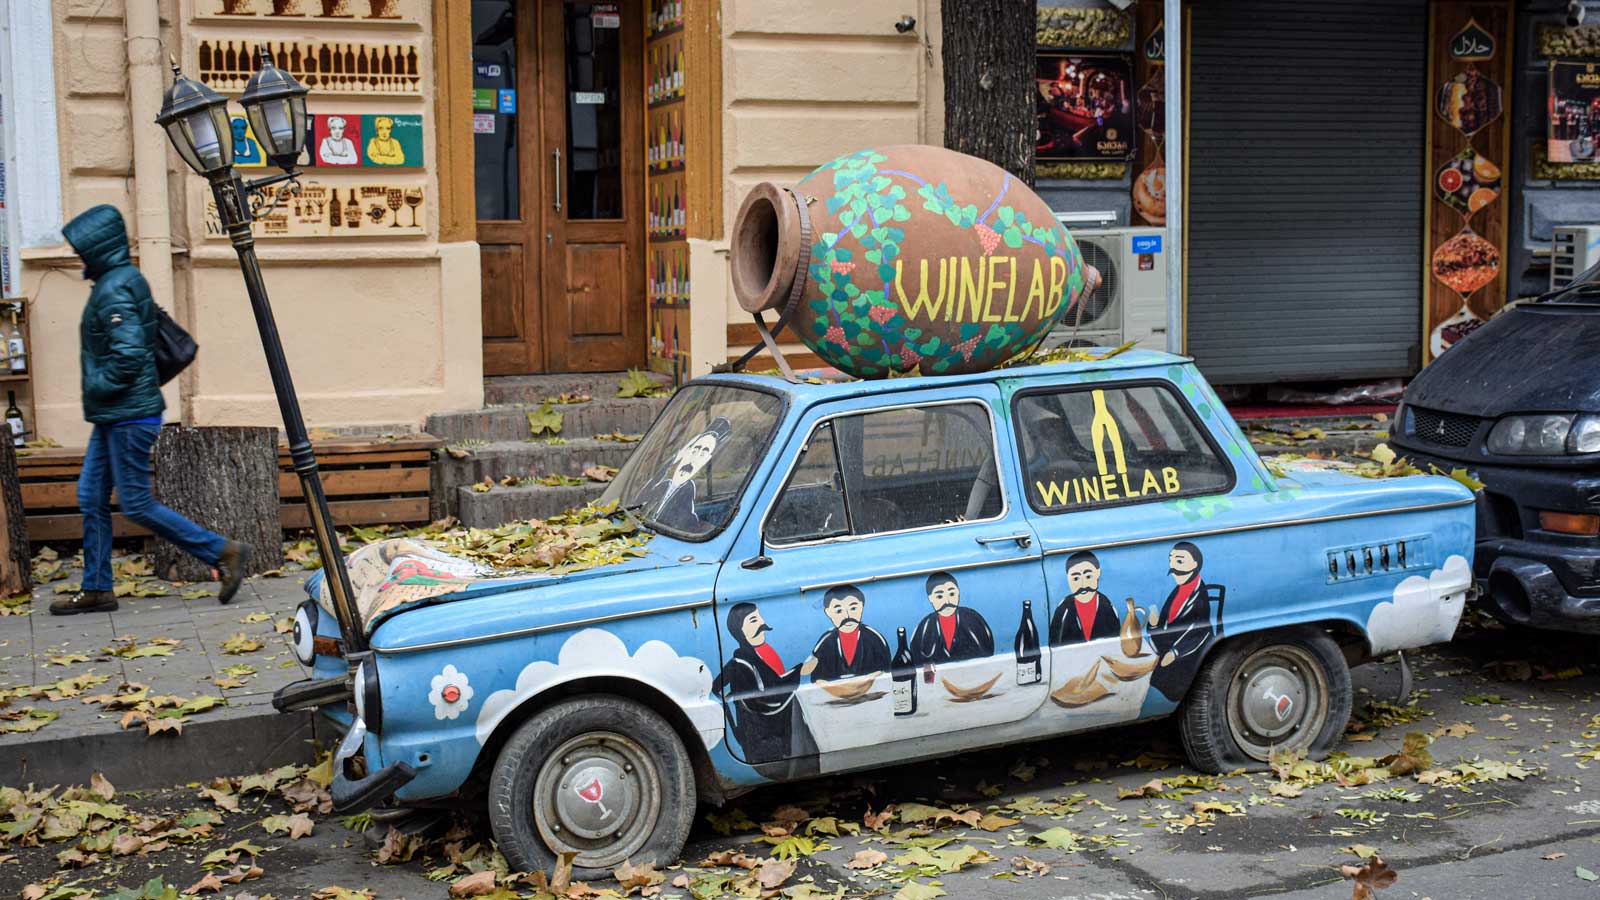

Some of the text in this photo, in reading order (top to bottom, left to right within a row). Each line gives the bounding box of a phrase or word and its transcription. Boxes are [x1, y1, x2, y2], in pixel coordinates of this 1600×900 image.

[1454, 35, 1490, 55] حلال
[577, 94, 604, 102] OPEN
[361, 186, 387, 194] SMILE
[895, 255, 1066, 323] WINELAB
[1036, 466, 1181, 507] WINELAB
